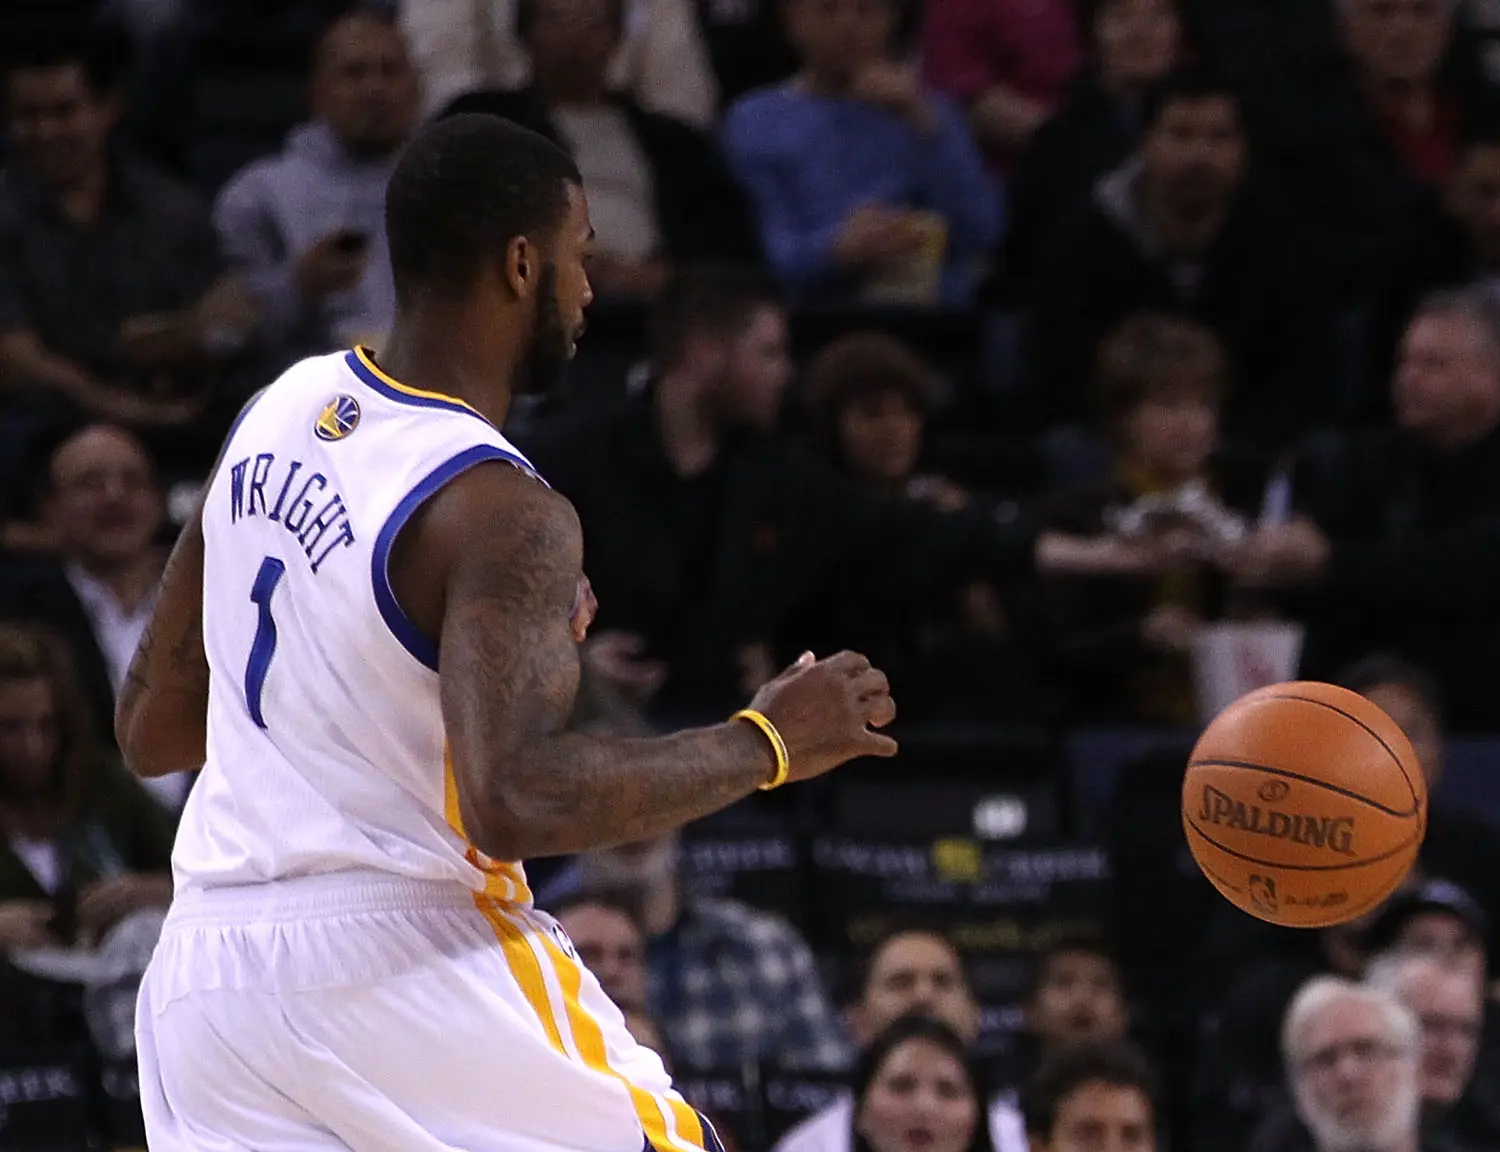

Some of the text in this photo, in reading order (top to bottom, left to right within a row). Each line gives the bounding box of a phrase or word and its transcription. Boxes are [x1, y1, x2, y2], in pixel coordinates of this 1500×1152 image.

[231, 453, 355, 574] WRIGHT
[245, 556, 286, 729] 1
[1200, 784, 1358, 856] SPALDING
